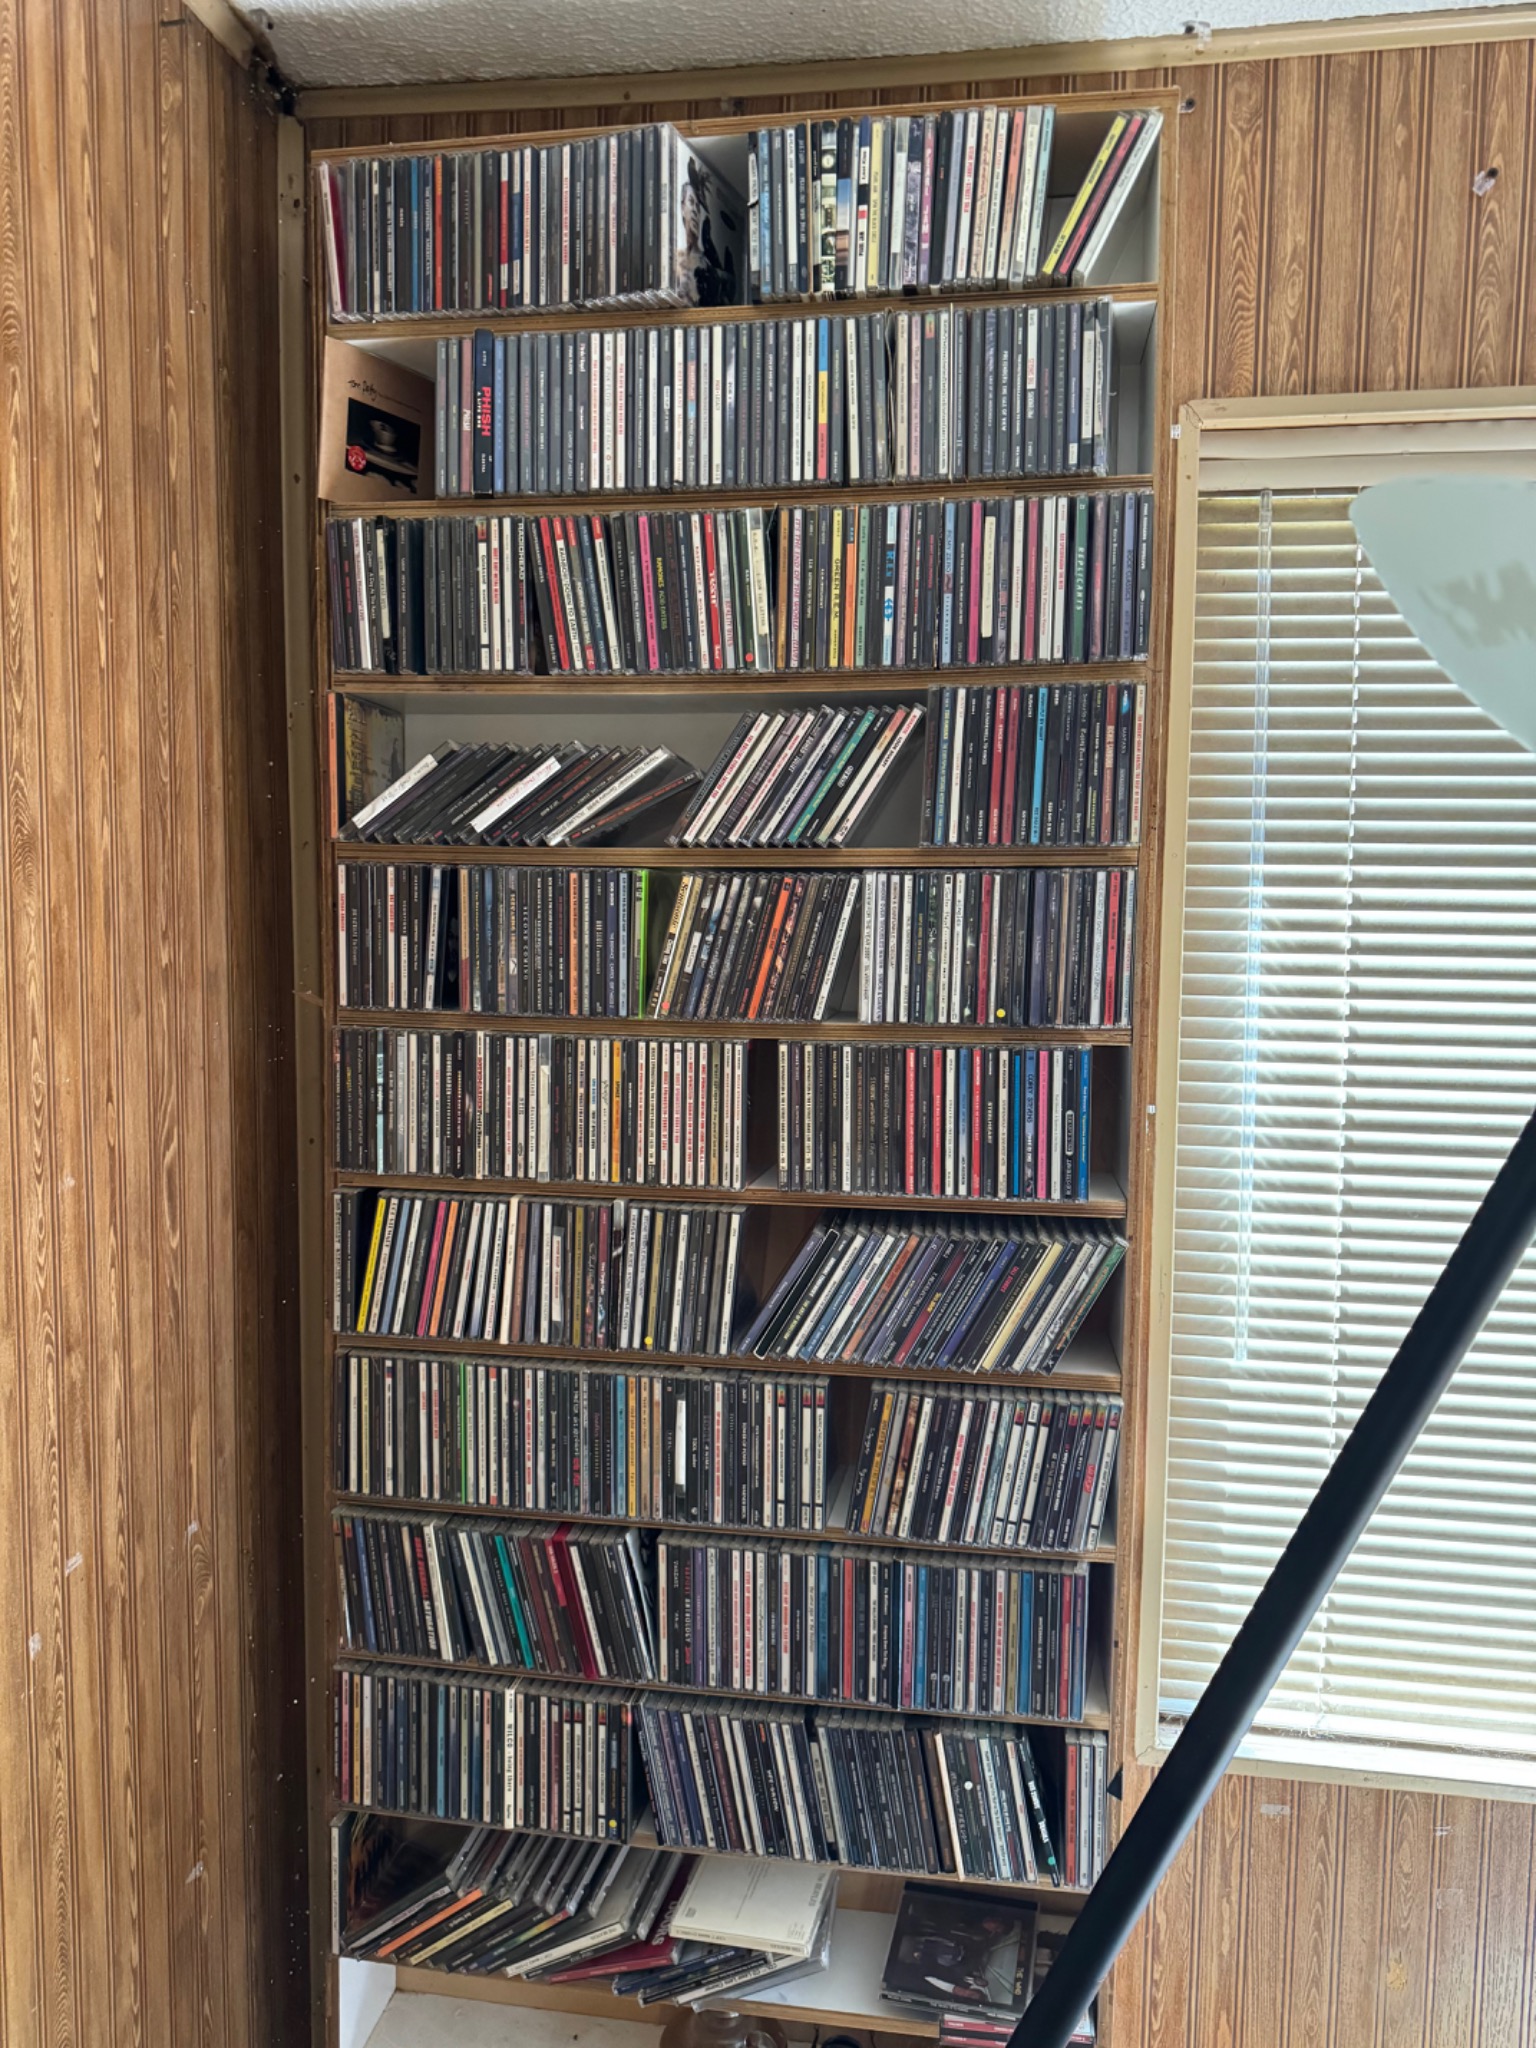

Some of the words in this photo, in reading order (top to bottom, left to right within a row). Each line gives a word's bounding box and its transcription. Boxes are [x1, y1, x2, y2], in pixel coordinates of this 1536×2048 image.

[481, 386, 491, 436] PHISH
[1075, 547, 1085, 611] REPLICANTS
[670, 881, 689, 929] Semisonic
[422, 1599, 436, 1650] SATURATION
